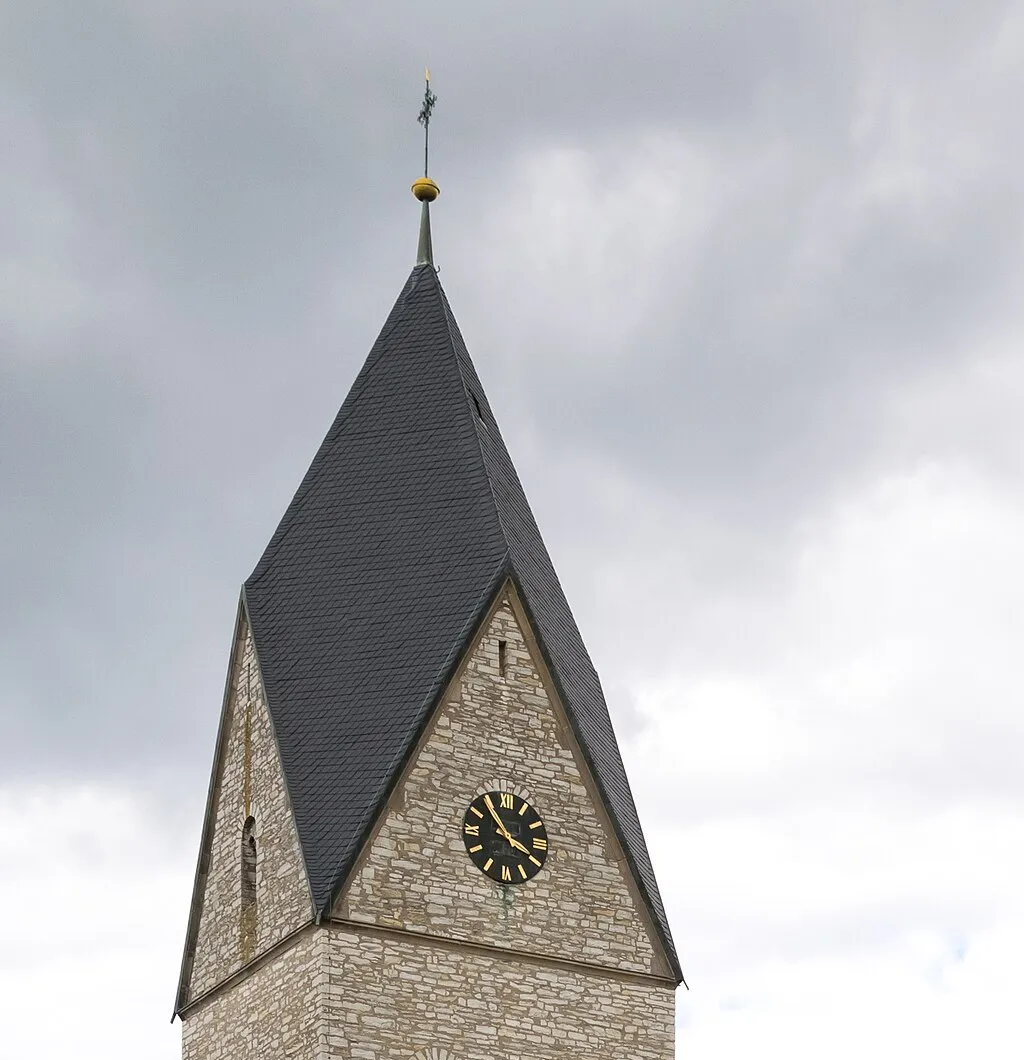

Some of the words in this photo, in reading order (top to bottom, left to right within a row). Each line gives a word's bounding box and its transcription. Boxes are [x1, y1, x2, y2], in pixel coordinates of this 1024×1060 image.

[500, 793, 514, 810] XII
[465, 823, 479, 836] IX
[532, 837, 547, 850] III
